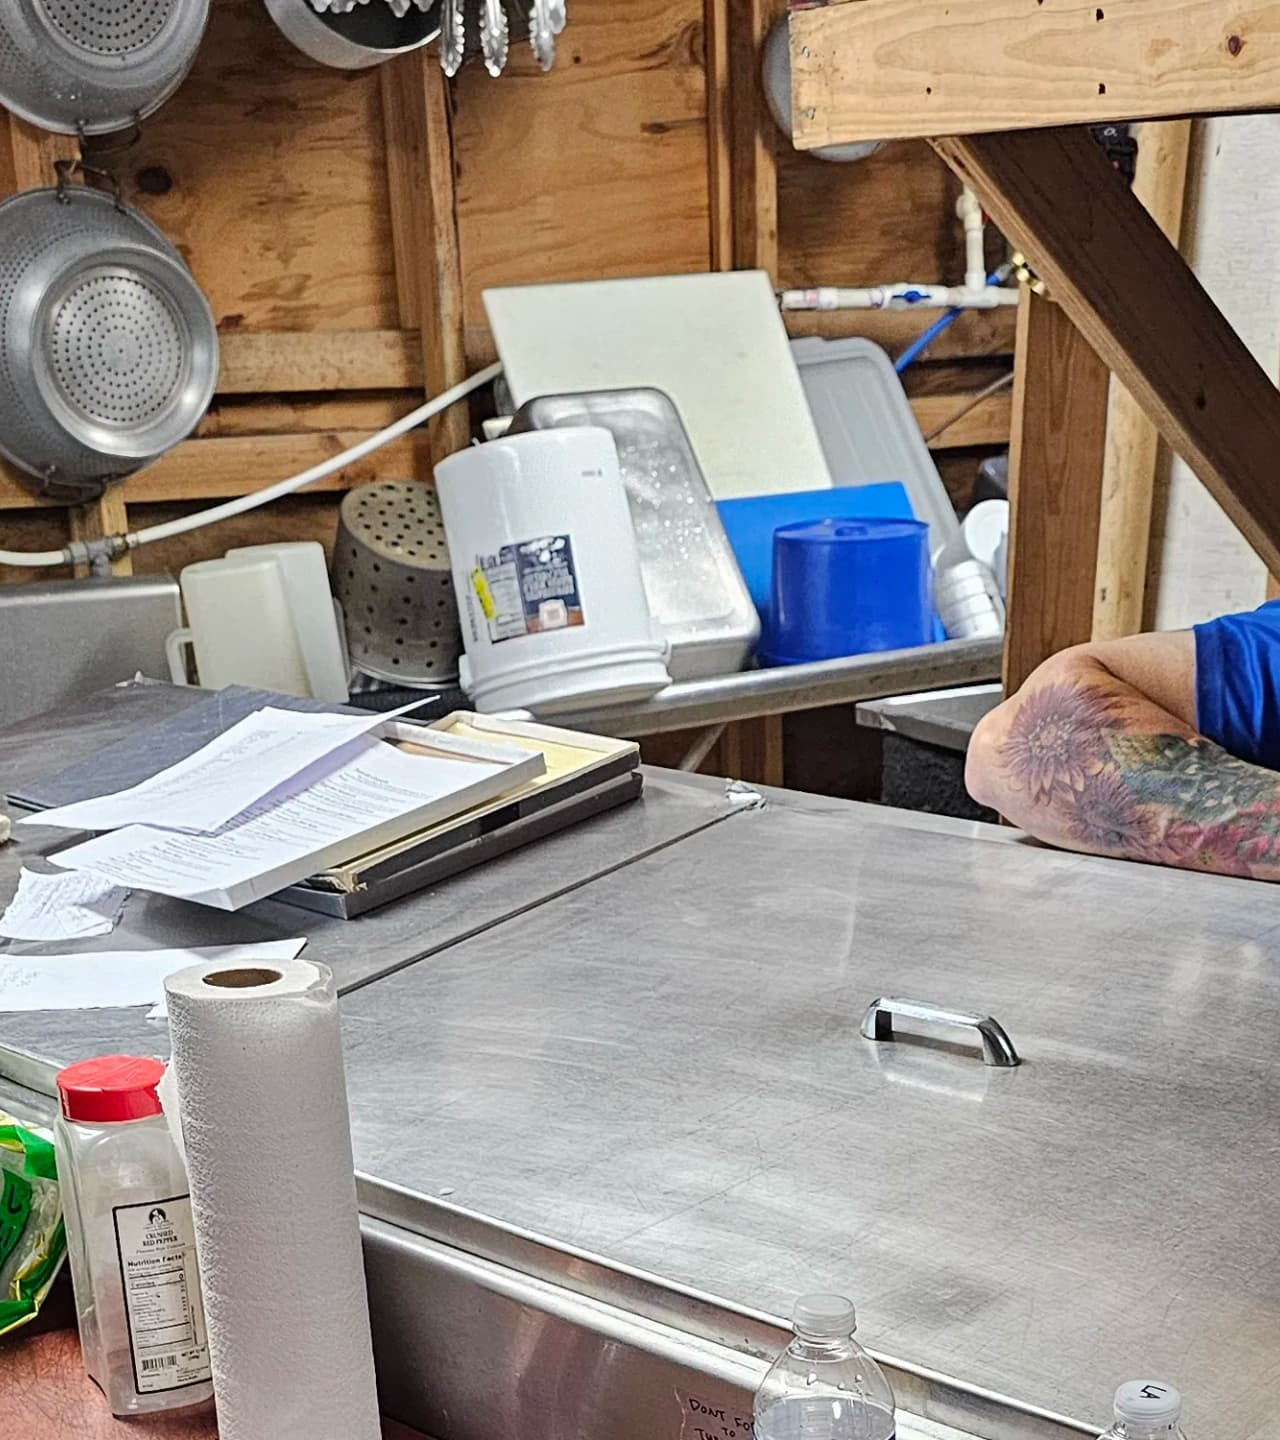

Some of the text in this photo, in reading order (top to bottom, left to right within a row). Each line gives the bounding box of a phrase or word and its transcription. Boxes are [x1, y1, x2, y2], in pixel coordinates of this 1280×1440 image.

[127, 1257, 161, 1268] Nutrition
[688, 1398, 725, 1421] DONT
[721, 1427, 735, 1438] TO
